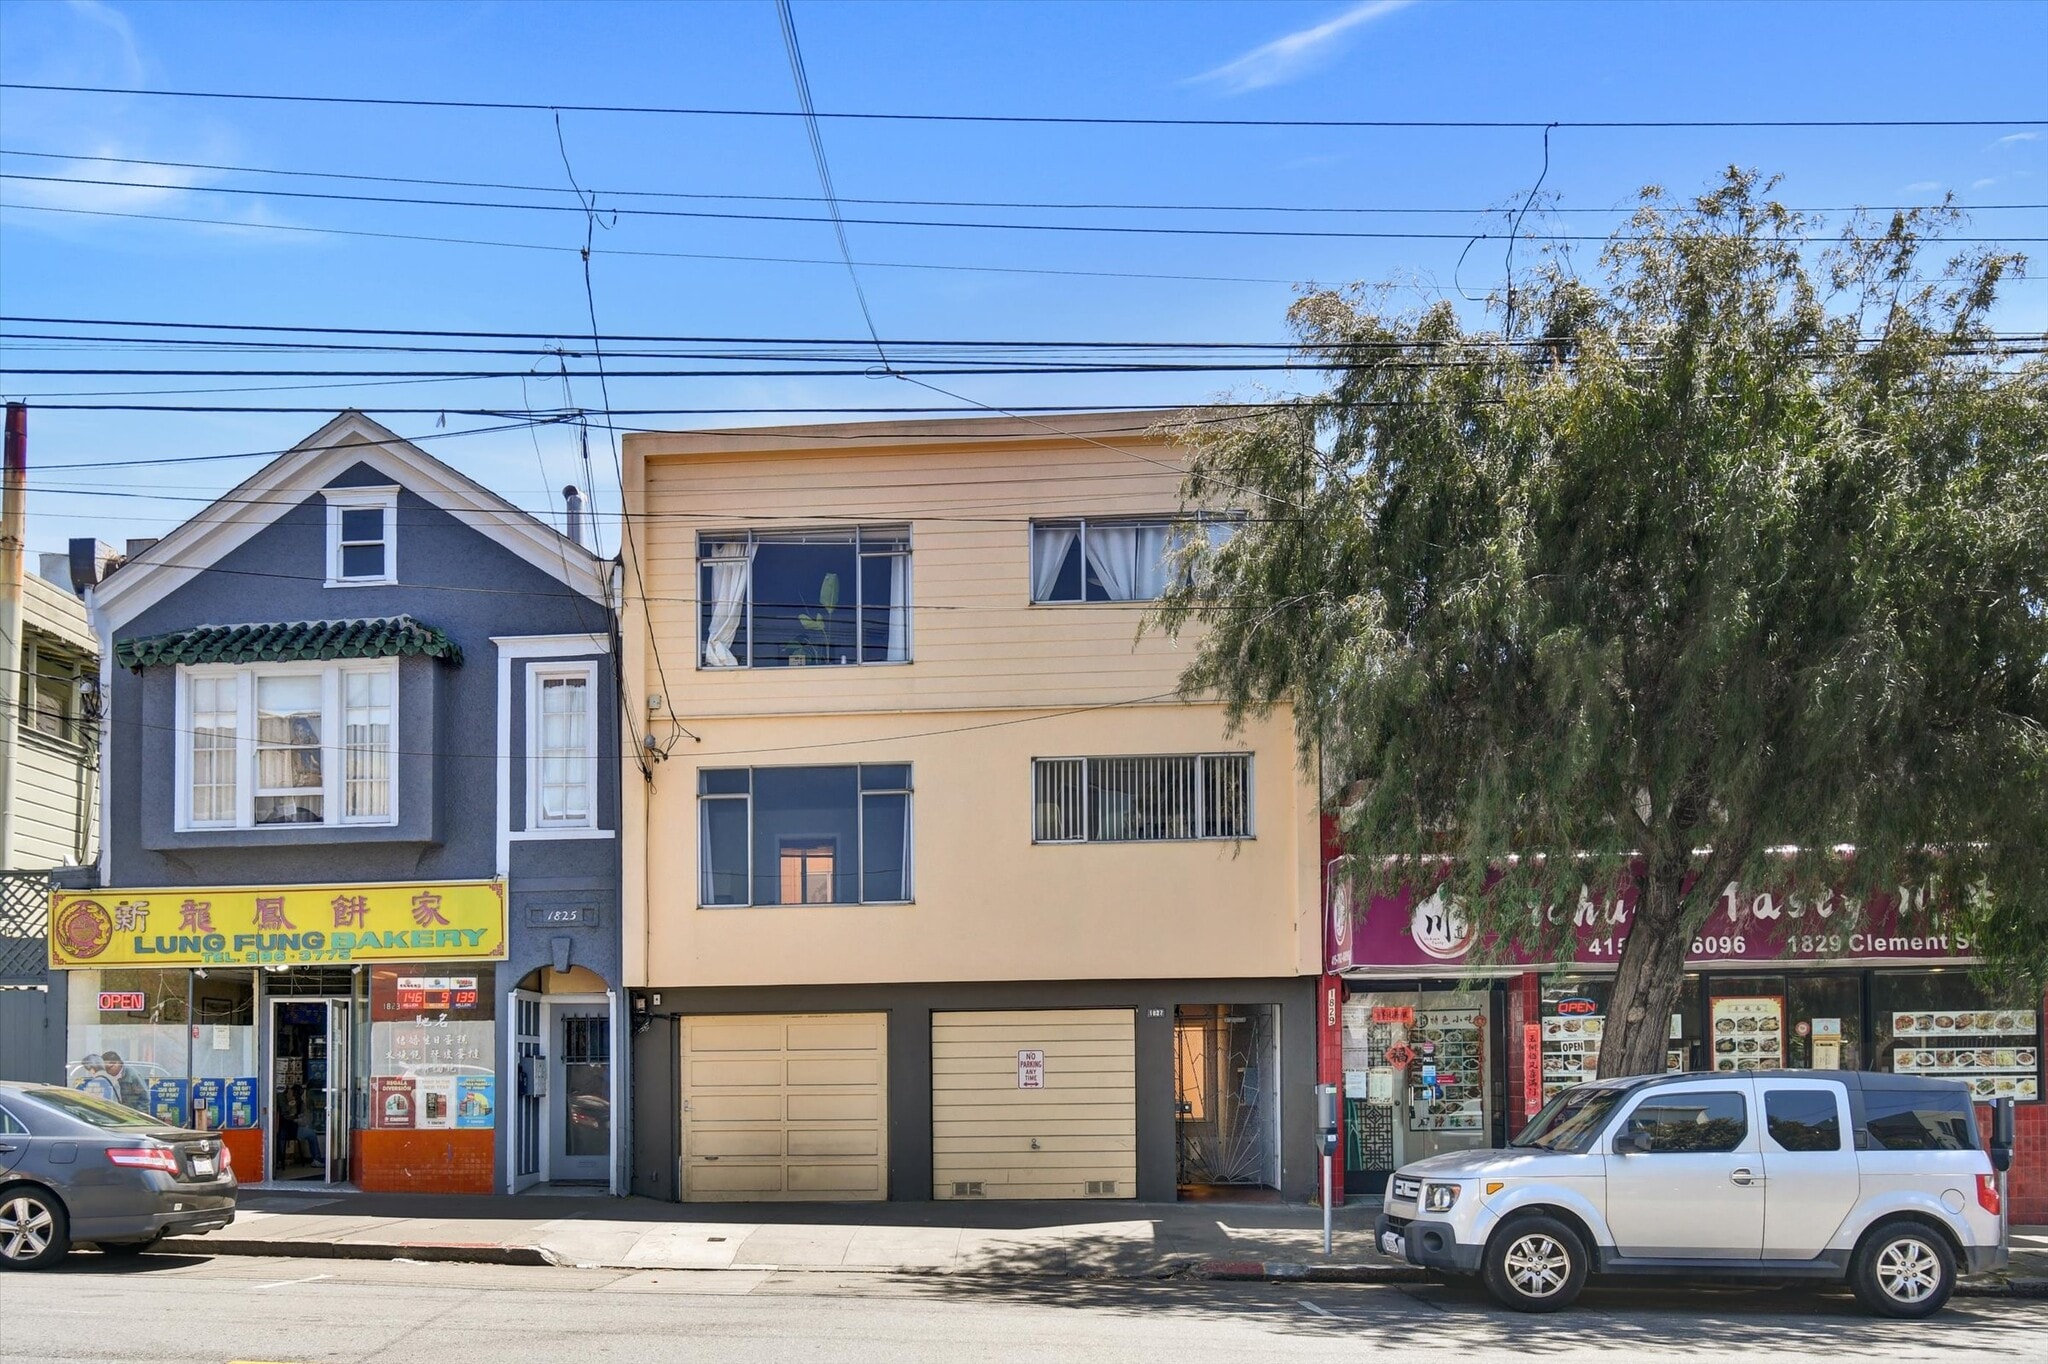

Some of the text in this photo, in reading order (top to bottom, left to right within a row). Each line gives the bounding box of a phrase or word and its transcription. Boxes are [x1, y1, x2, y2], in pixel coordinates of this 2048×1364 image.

[547, 910, 578, 921] 1825
[134, 928, 489, 954] LUNG FUNG BAKERY
[1787, 934, 1842, 953] 1829
[1849, 932, 1949, 952] Clement
[201, 951, 240, 963] TEL.
[99, 994, 142, 1010] OPEN
[403, 992, 476, 1003] 146 9 139
[383, 1002, 401, 1011] 1823
[1558, 1002, 1596, 1013] OPEN
[1562, 1042, 1584, 1052] OPEN
